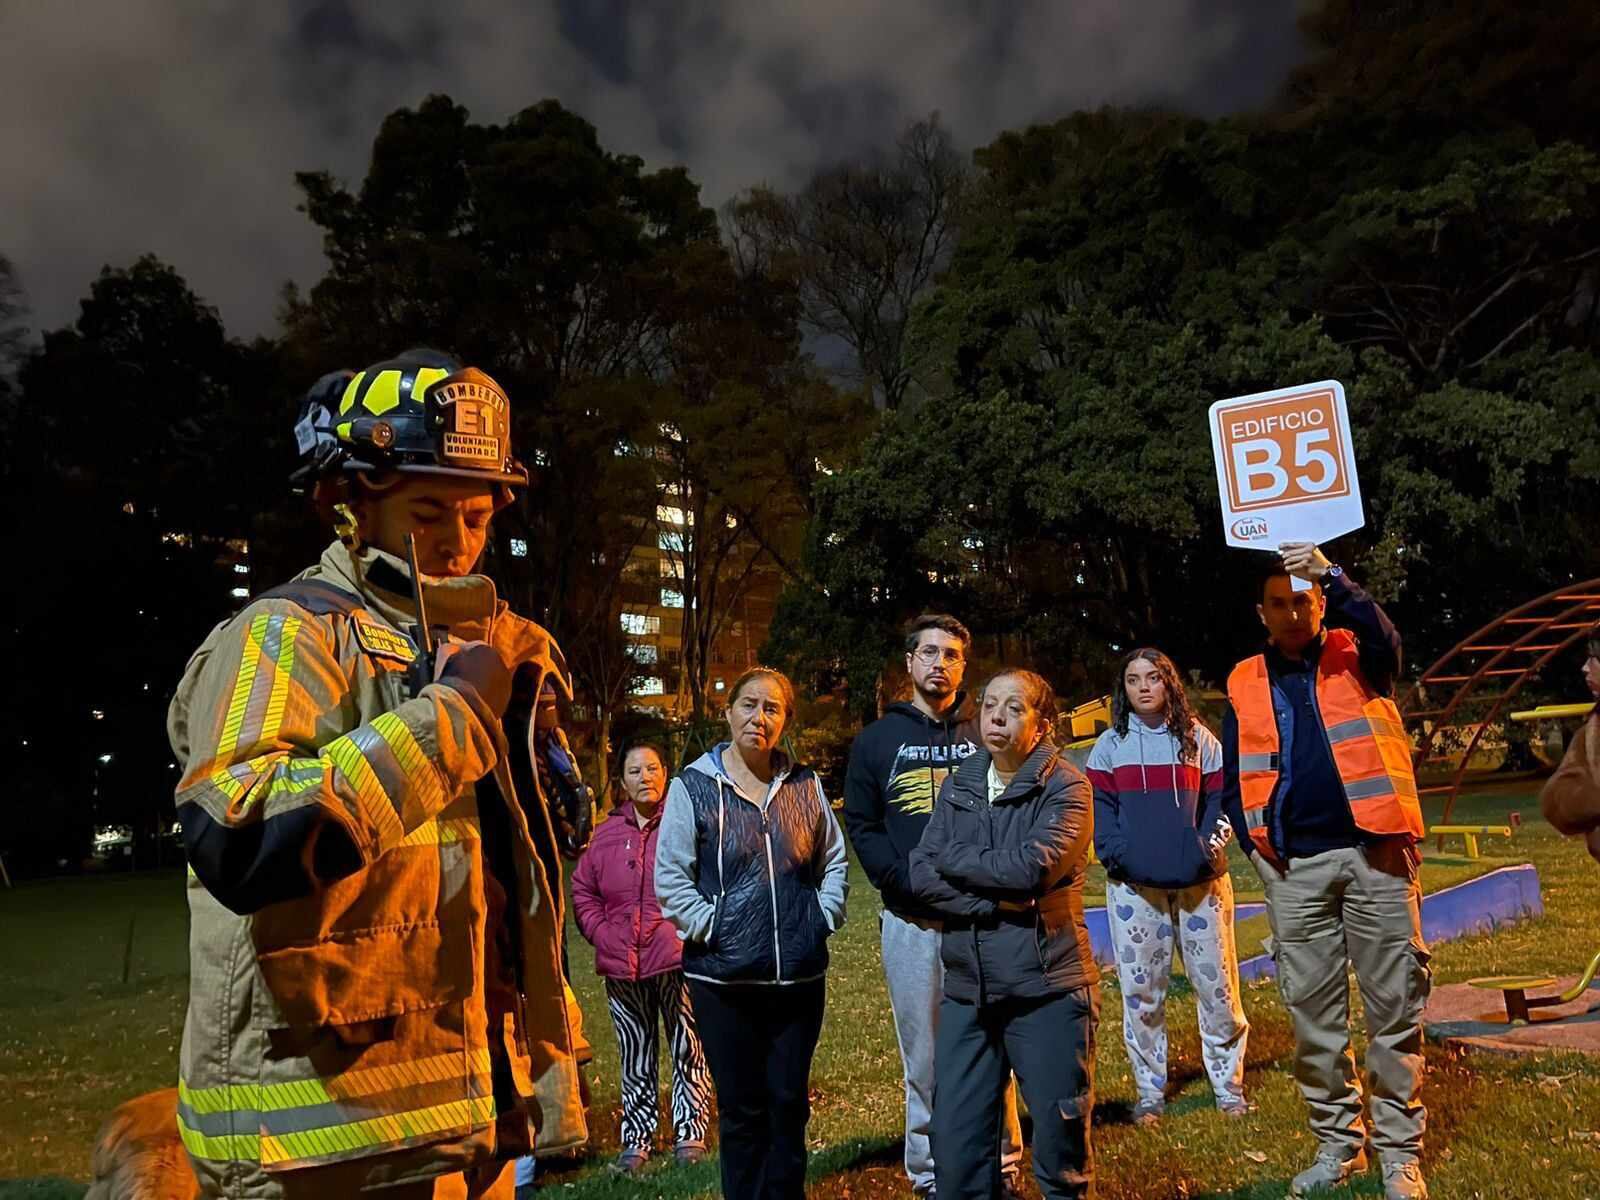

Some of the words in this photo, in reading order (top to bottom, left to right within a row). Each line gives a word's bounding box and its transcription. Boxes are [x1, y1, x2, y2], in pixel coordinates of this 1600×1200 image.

[455, 400, 494, 436] E1
[1231, 408, 1324, 439] EDIFICIO
[446, 433, 497, 447] VOLUNTARIOS
[1231, 428, 1338, 503] B5
[1240, 523, 1267, 536] UAN
